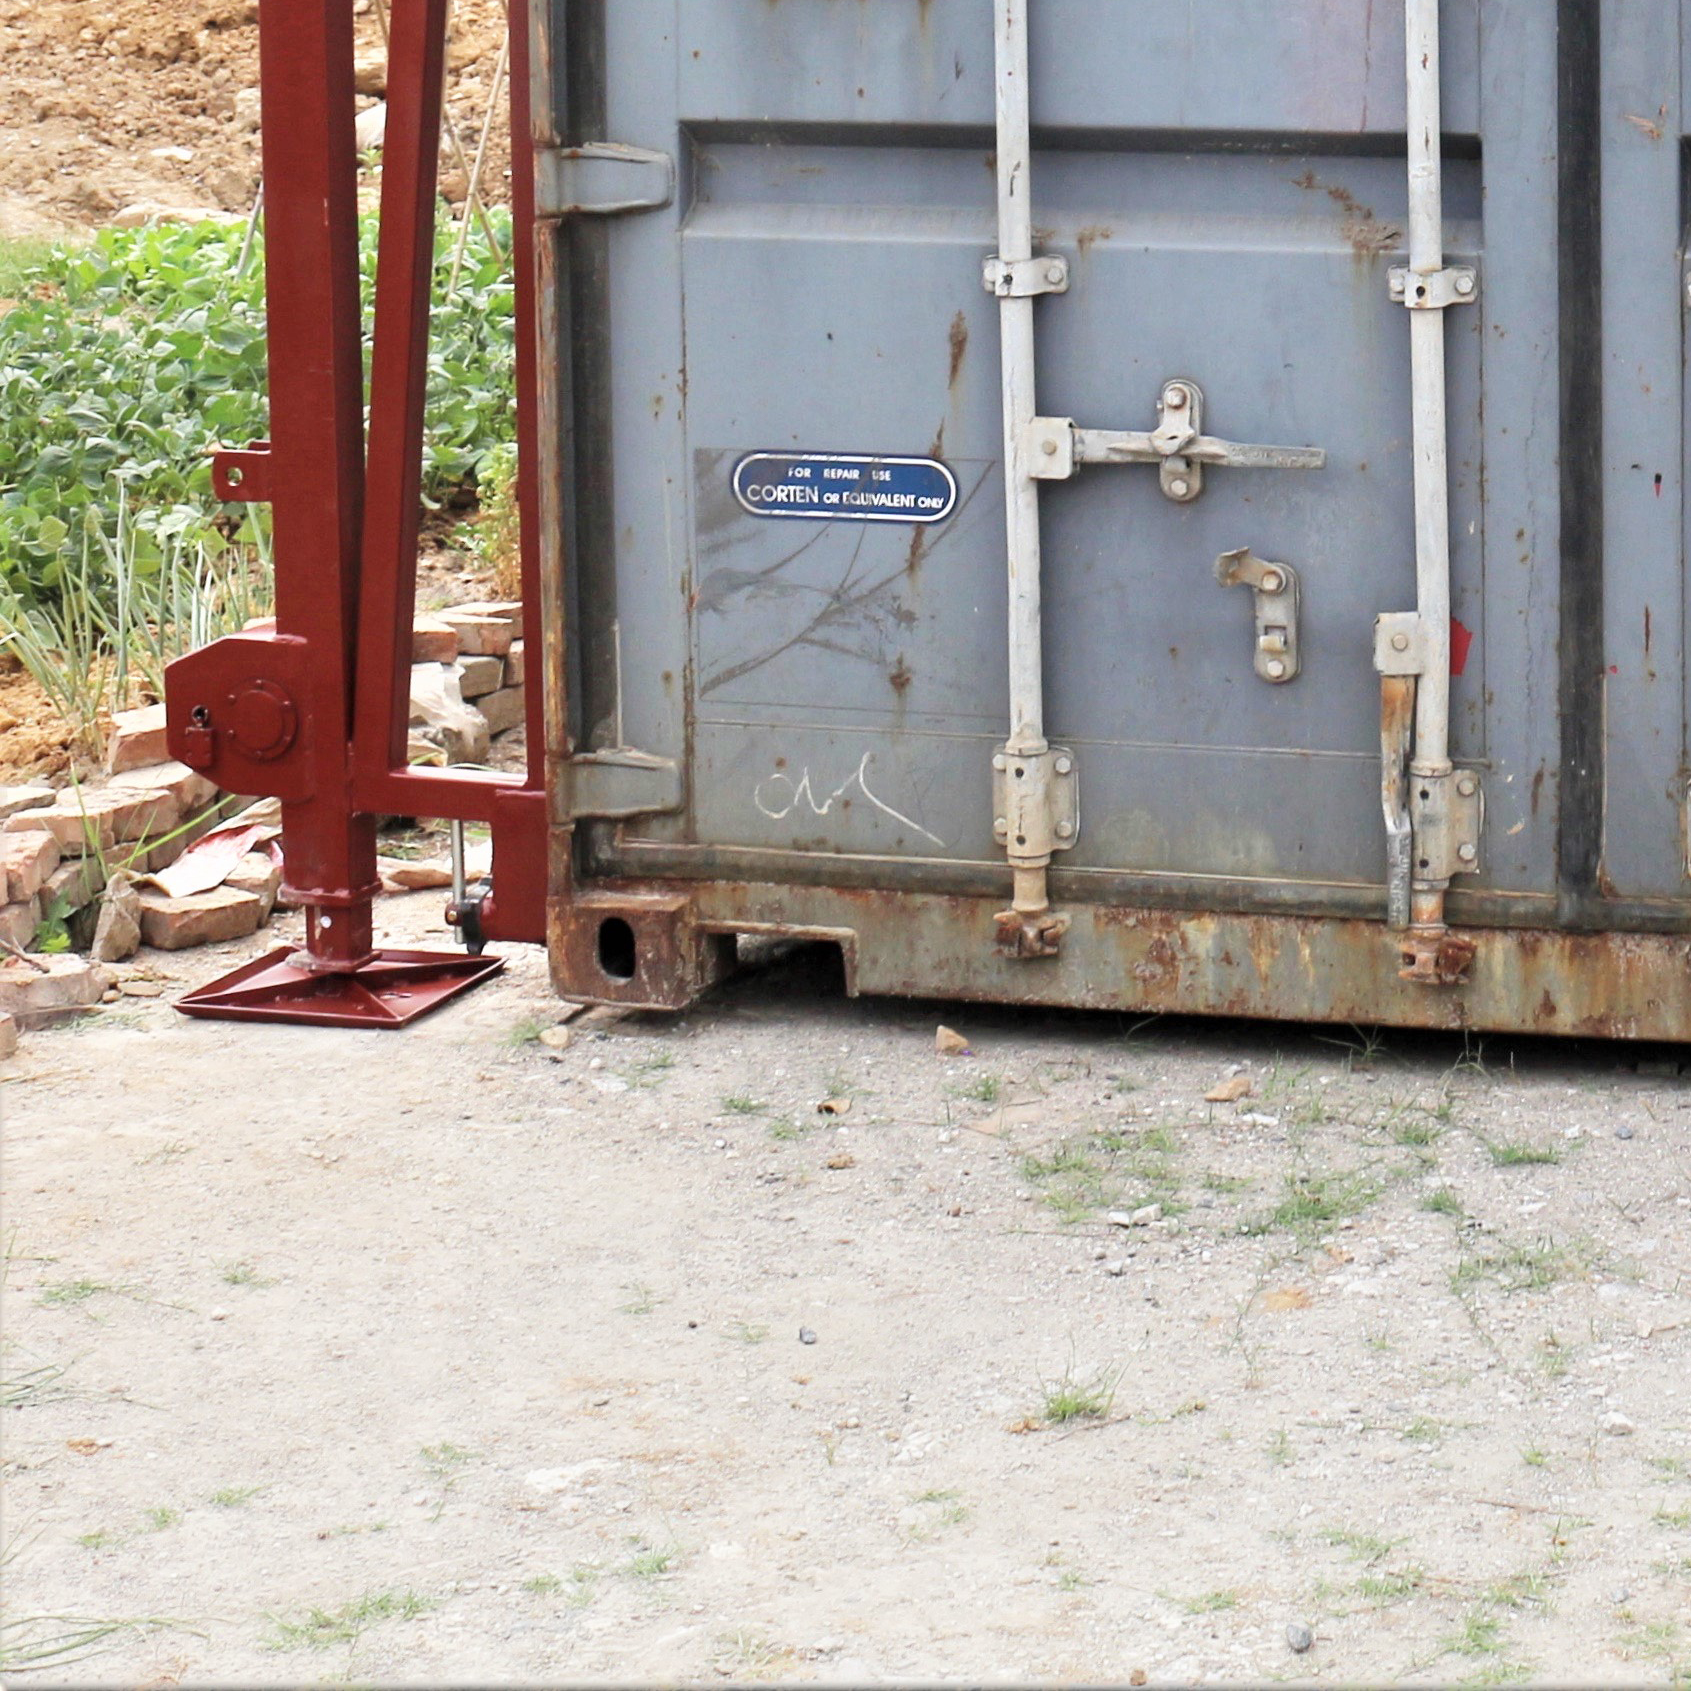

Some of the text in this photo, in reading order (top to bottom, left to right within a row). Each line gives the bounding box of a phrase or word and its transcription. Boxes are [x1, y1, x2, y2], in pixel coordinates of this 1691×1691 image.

[788, 466, 892, 482] FOR REPAIR USE
[747, 484, 945, 510] CORTEN OR EQUIVALENT ONLY
